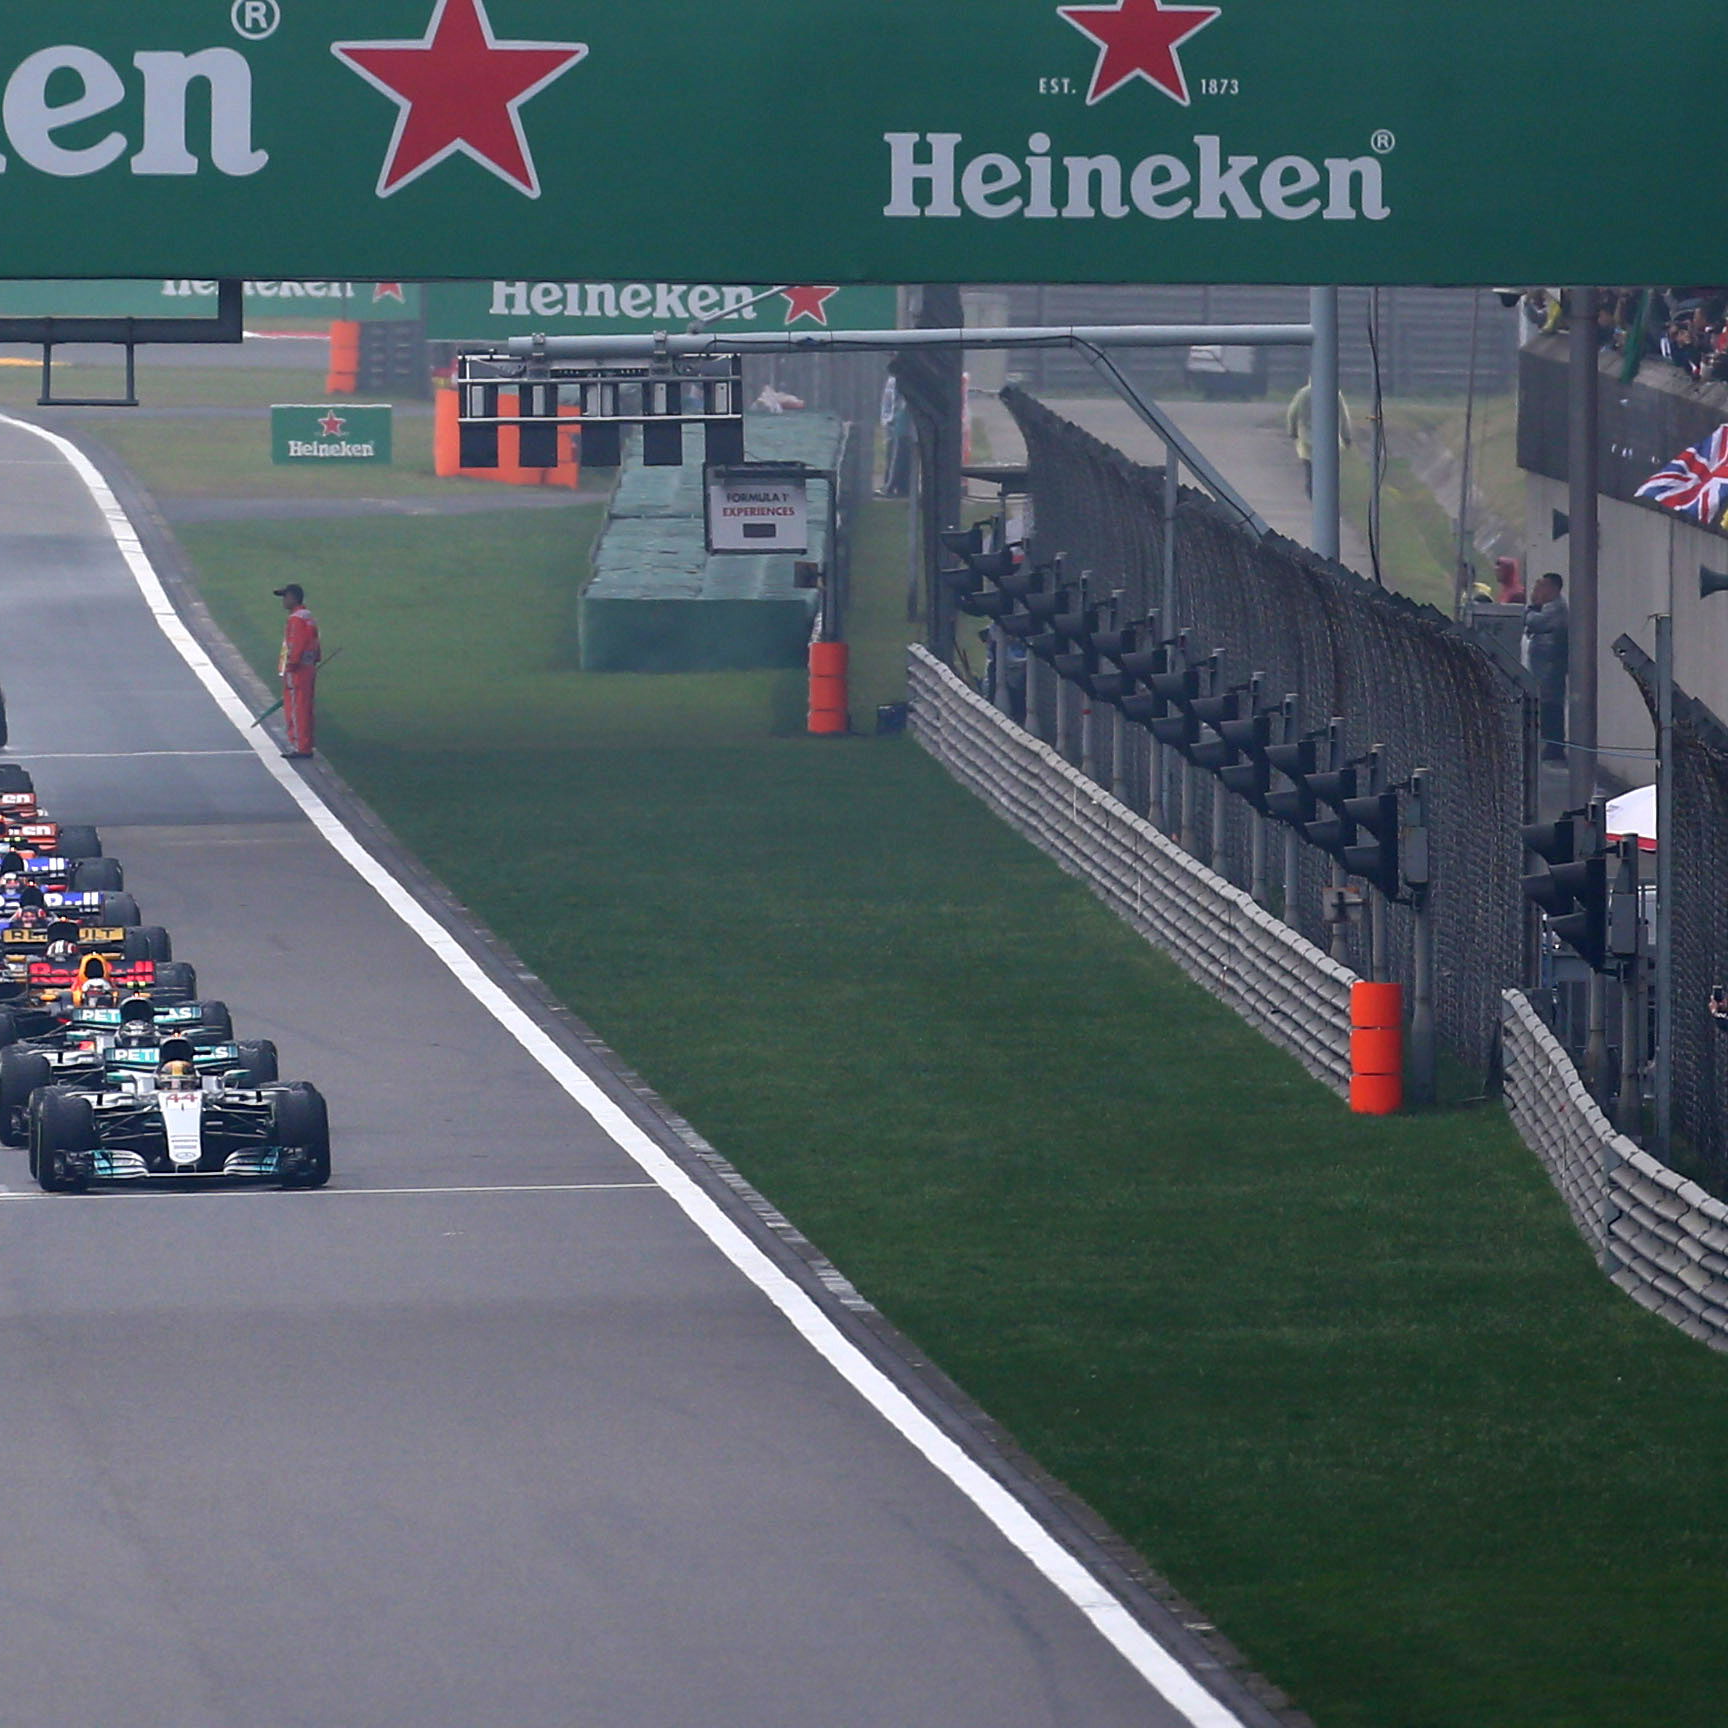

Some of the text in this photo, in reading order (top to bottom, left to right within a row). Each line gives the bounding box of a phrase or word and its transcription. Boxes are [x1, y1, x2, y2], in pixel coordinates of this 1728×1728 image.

[1039, 78, 1240, 95] EST. 1873
[489, 281, 757, 319] Heineken
[726, 492, 781, 503] FORMULA
[722, 506, 796, 517] EXPERIENCES
